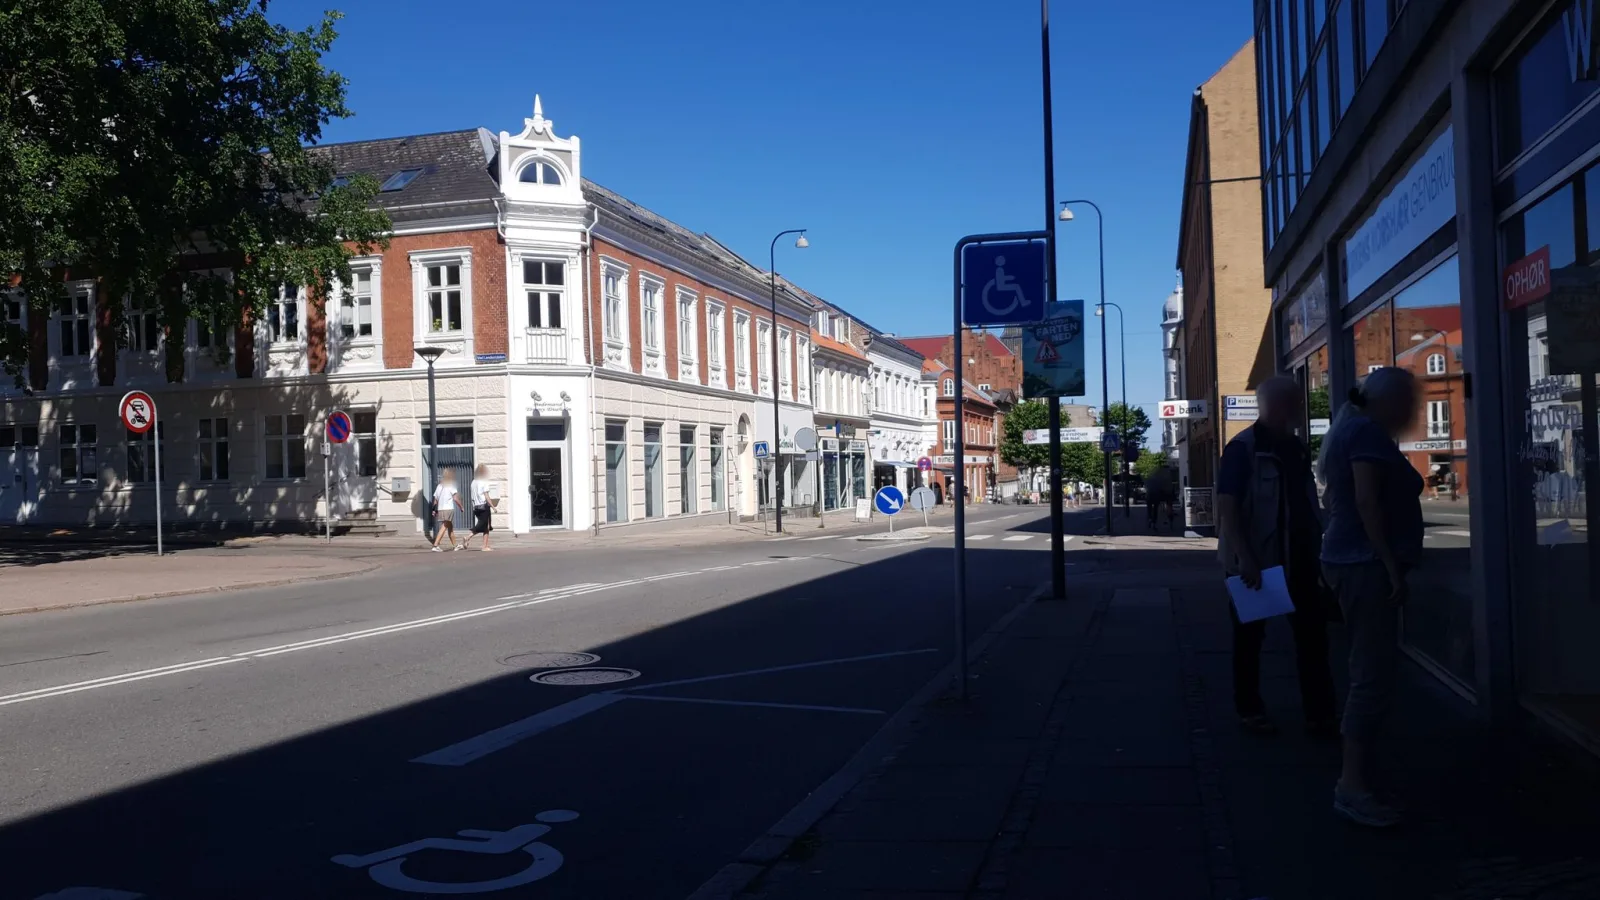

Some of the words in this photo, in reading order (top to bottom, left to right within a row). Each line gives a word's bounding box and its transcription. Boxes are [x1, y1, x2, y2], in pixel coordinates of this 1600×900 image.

[1506, 259, 1546, 301] OPHØR
[1036, 321, 1077, 337] FARTEN
[1051, 332, 1072, 342] NED
[1179, 403, 1203, 415] bank
